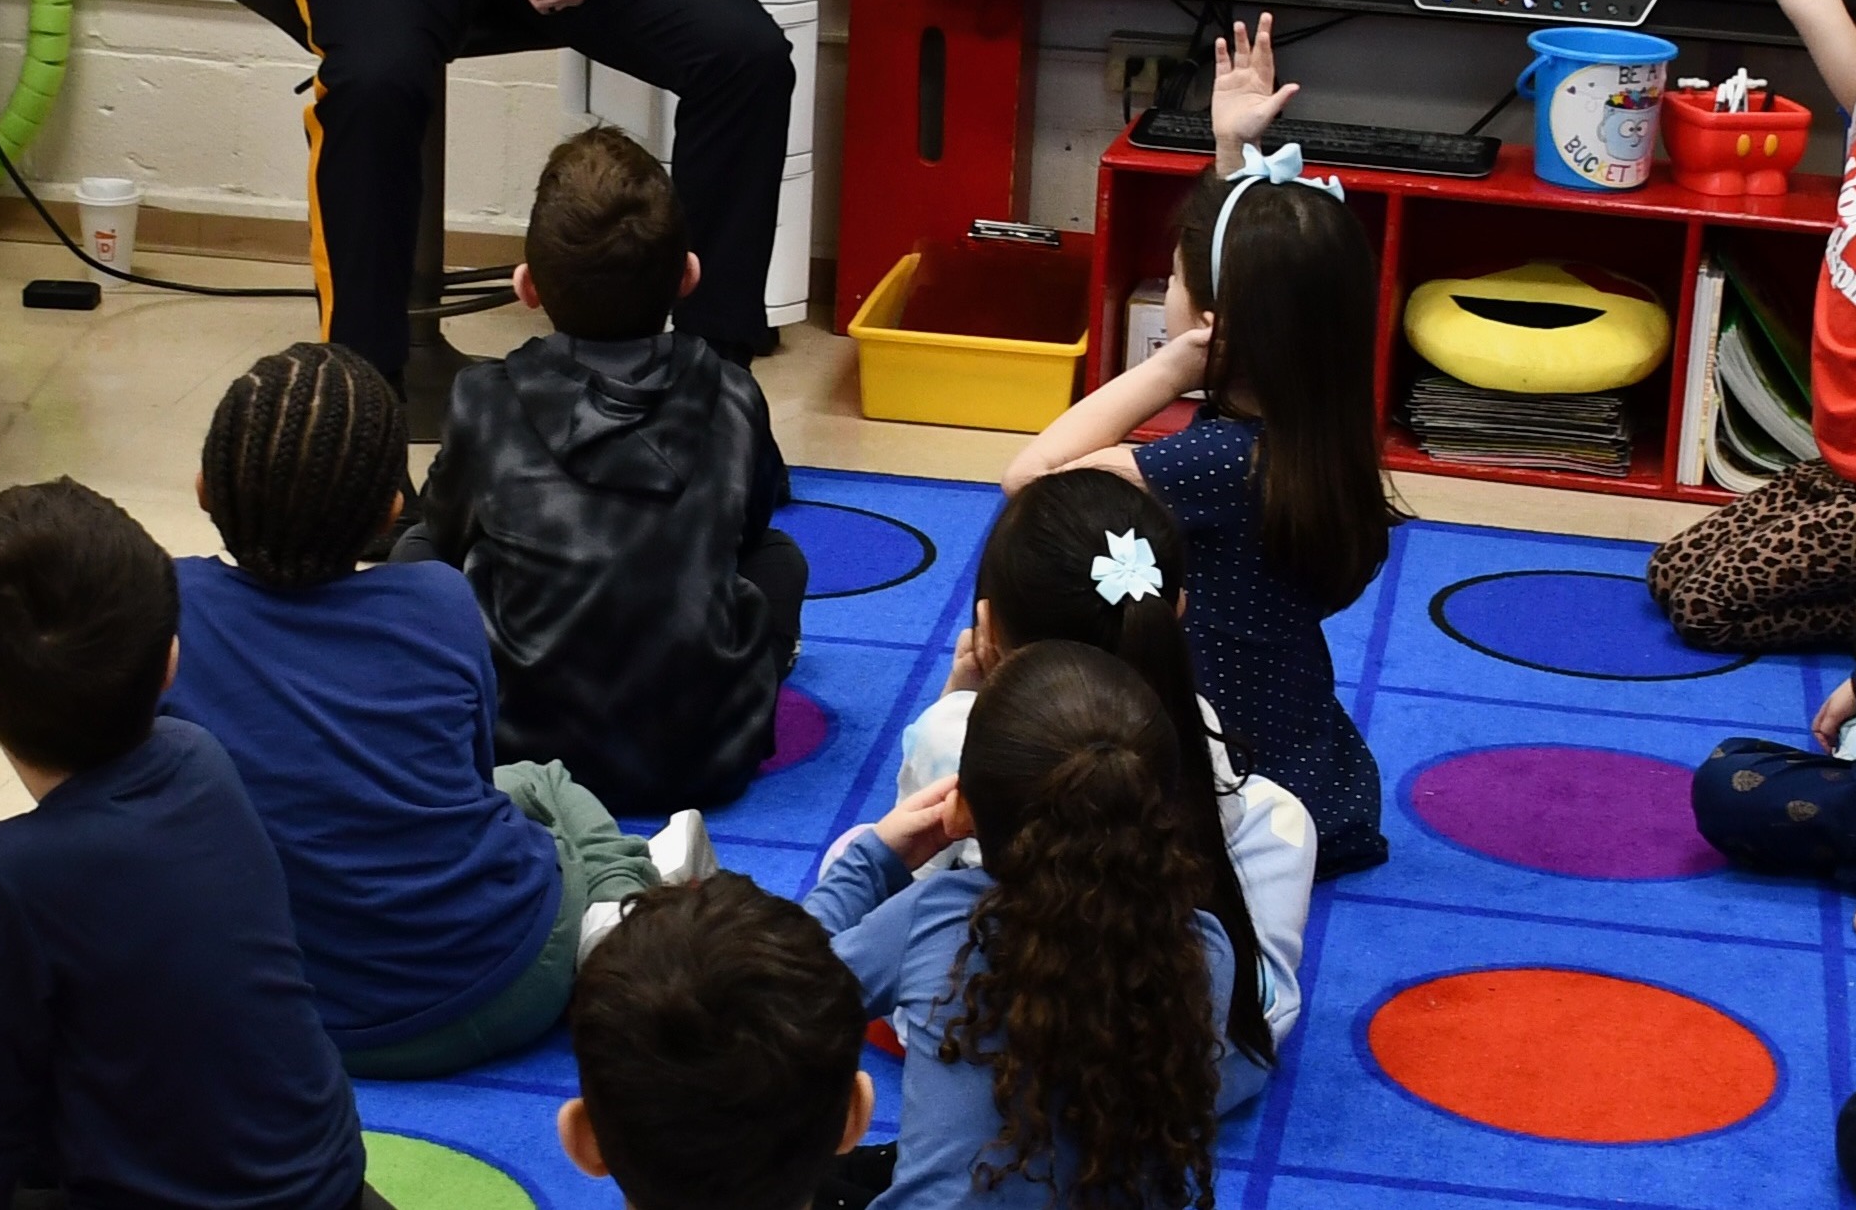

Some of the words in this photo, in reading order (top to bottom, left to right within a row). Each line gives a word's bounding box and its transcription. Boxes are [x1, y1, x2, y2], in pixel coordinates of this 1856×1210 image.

[1619, 65, 1642, 85] BE
[1647, 64, 1657, 81] A
[1564, 135, 1631, 182] BUCKET
